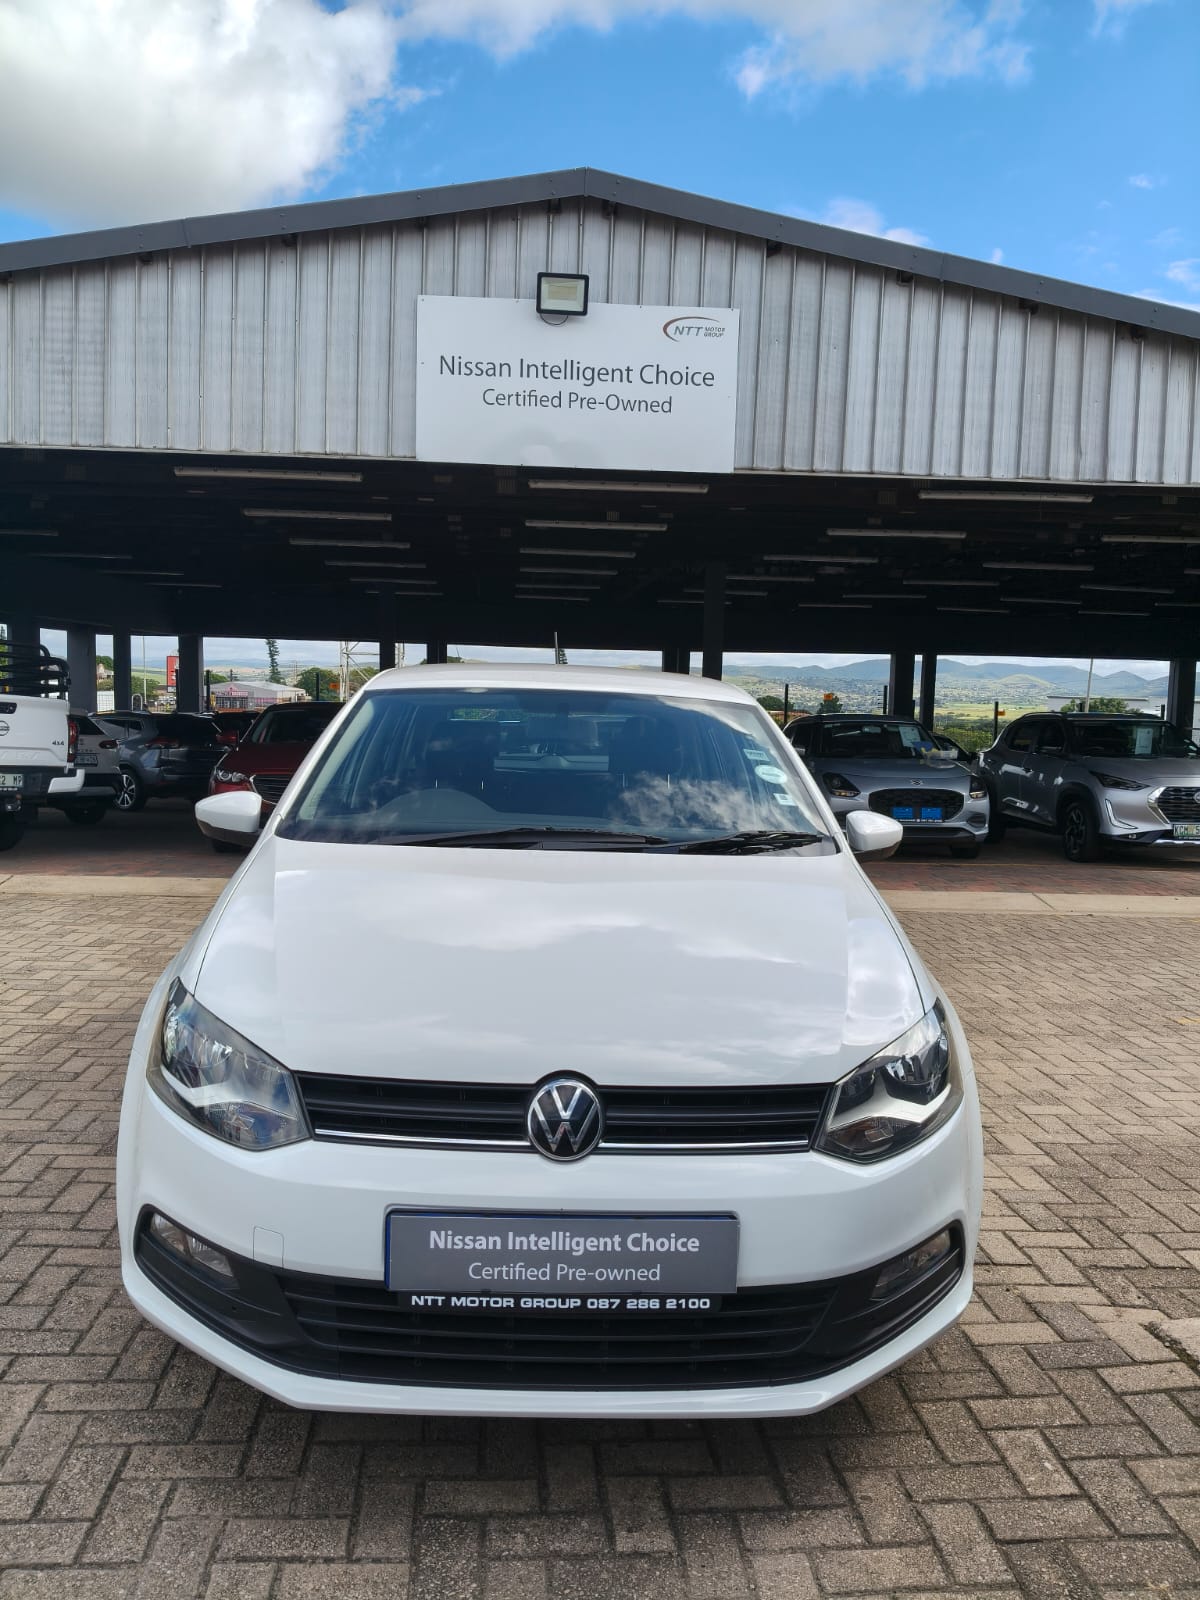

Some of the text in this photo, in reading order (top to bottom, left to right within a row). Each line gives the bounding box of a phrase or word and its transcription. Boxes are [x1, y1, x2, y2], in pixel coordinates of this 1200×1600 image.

[673, 325, 703, 337] NTT
[439, 354, 715, 388] Nissan Intelligent Choice
[482, 388, 673, 414] Certified Pre-Owned
[13, 776, 23, 785] MP
[429, 1230, 700, 1256] Nissan Intelligent Choice
[468, 1262, 661, 1282] Certified Pre-owned
[411, 1295, 711, 1311] NTT MOTOR GROUP 087 286 2100
